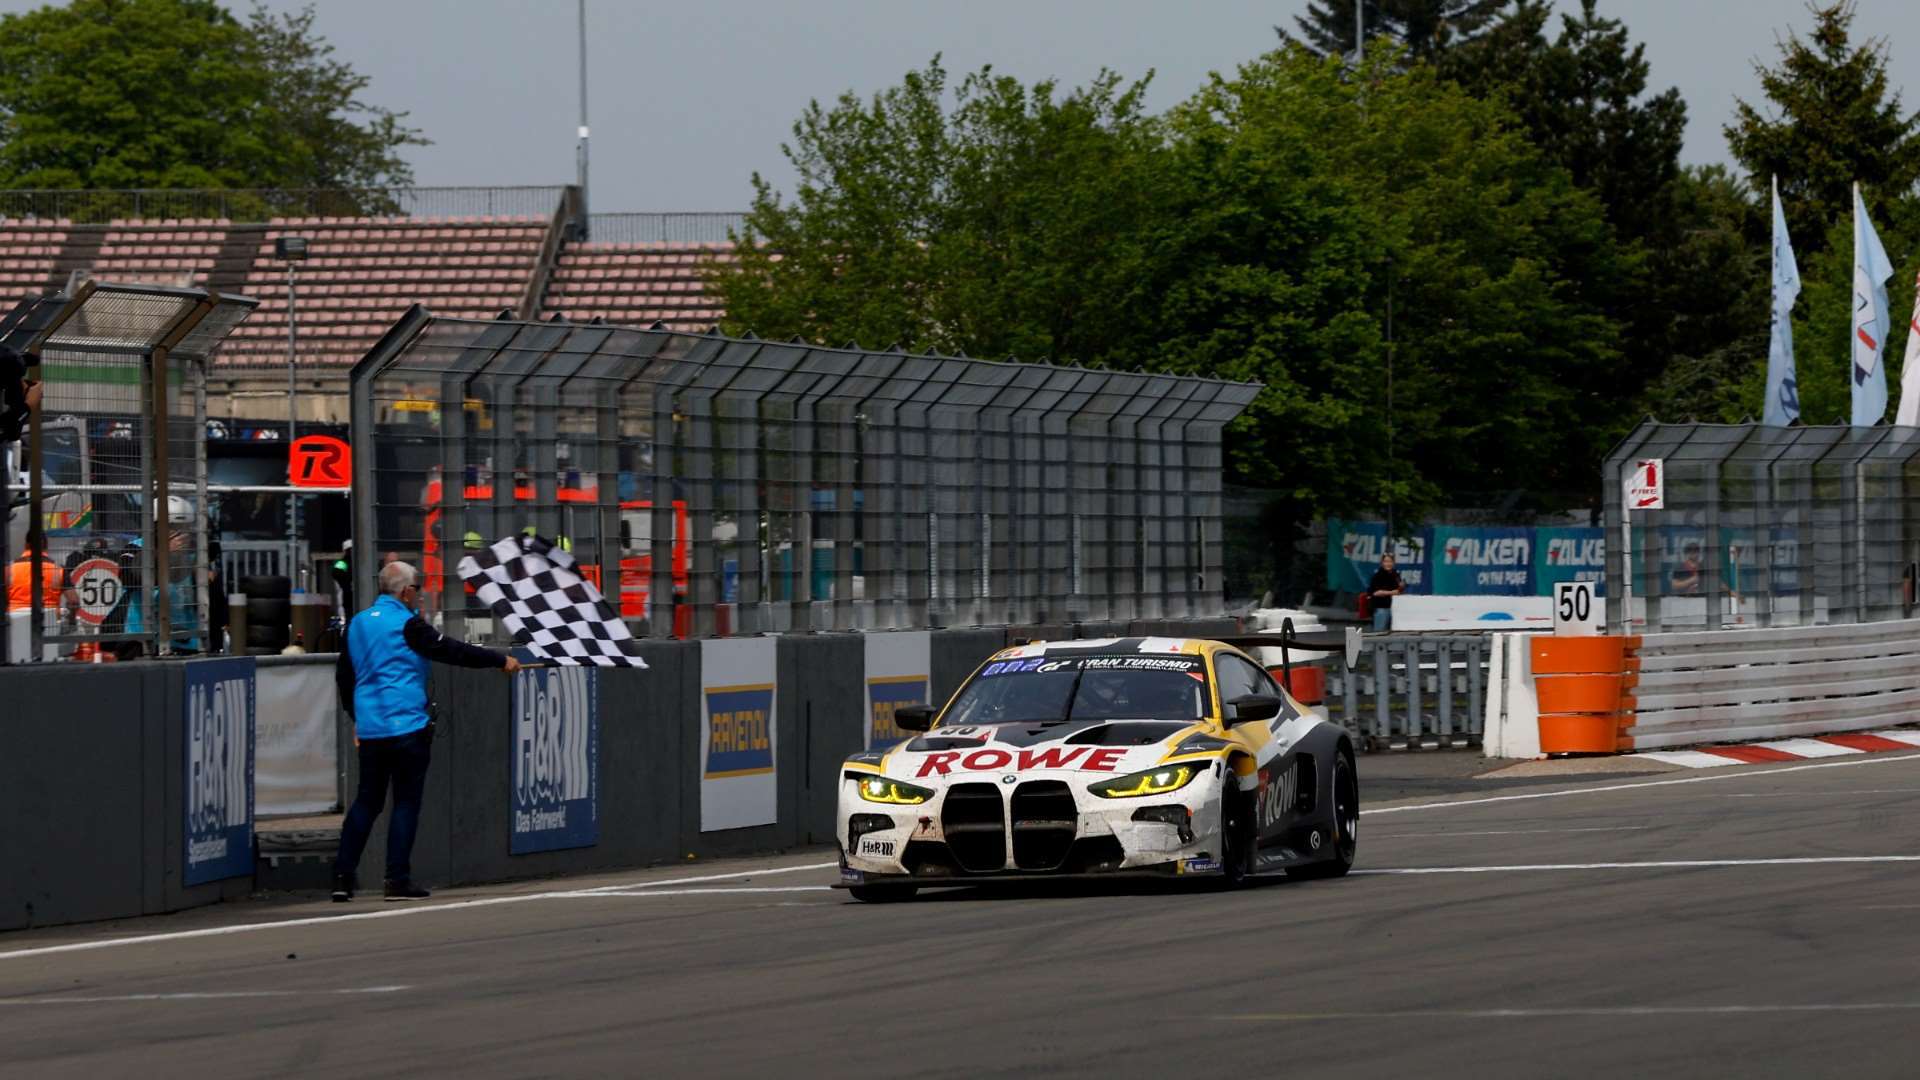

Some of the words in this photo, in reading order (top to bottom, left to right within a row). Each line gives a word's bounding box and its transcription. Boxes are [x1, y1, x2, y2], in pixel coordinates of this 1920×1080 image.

[1444, 537, 1529, 566] FALKEN
[1546, 538, 1605, 567] FALKE
[82, 578, 117, 605] 50
[1560, 585, 1590, 621] 50
[516, 667, 564, 805] H&R
[712, 710, 769, 752] RAVENOL
[189, 683, 226, 831] H&R
[915, 747, 1129, 778] ROWE
[1265, 761, 1298, 827] ROW
[515, 809, 530, 833] Das
[862, 841, 881, 854] H&R
